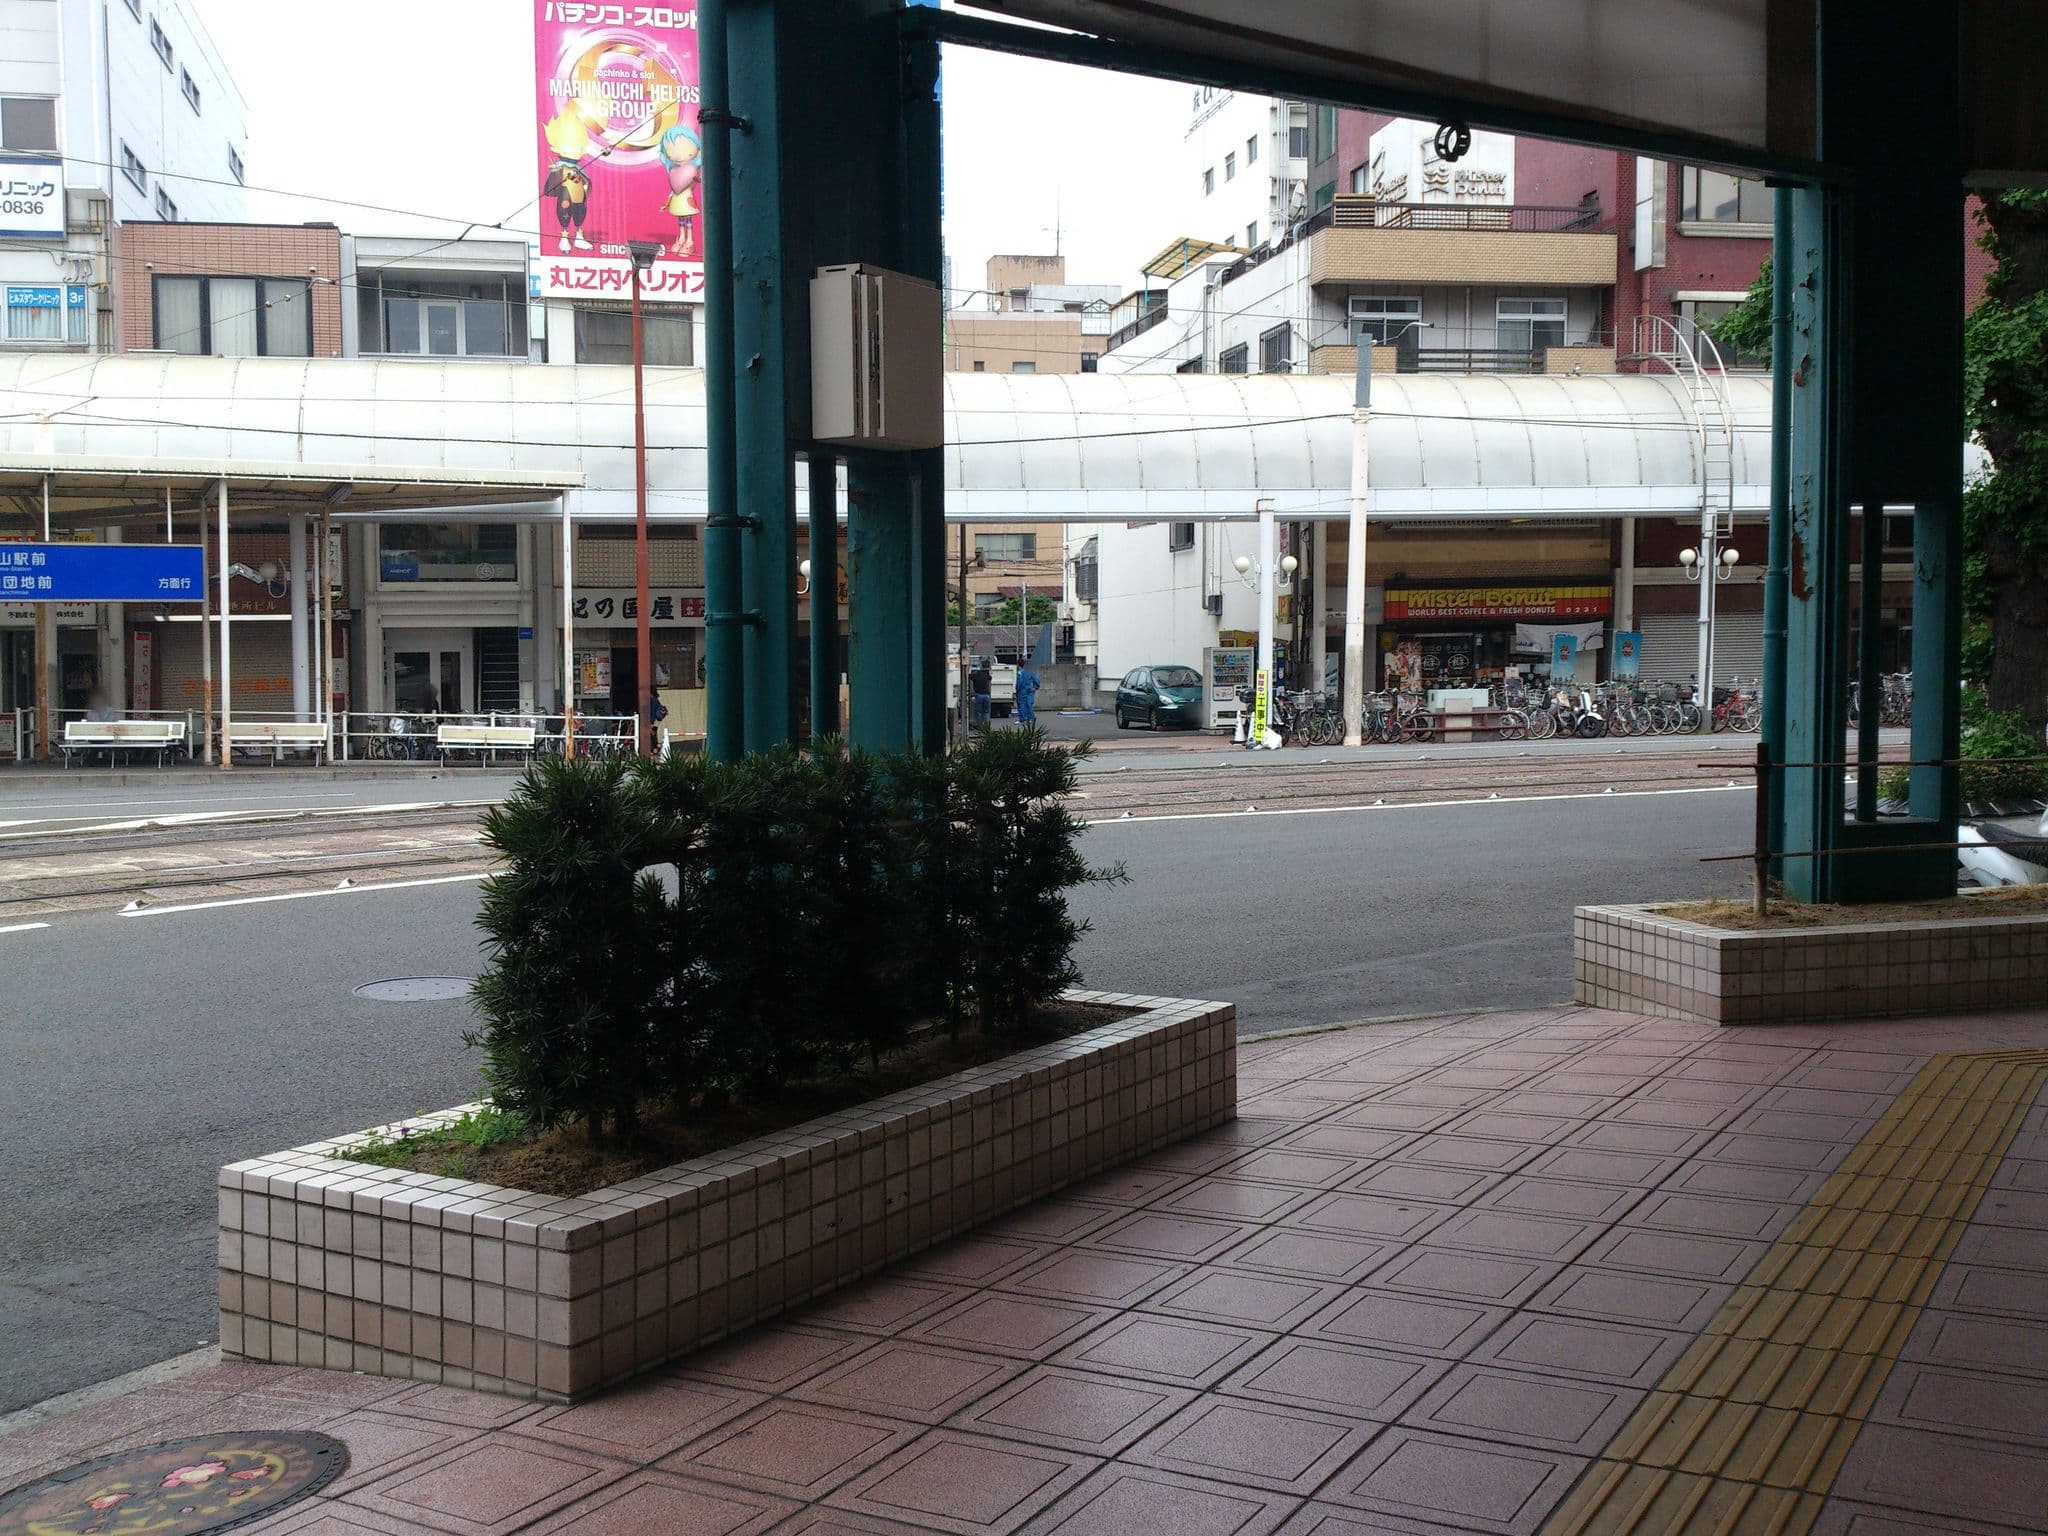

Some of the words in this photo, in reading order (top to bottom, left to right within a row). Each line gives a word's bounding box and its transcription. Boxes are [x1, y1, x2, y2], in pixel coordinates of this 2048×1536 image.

[632, 70, 638, 79] &
[640, 69, 655, 80] slot
[550, 79, 644, 101] MARUNOUCHI
[651, 84, 699, 104] HELIOS
[602, 100, 657, 119] GROUP
[0, 181, 54, 197] リニック
[1455, 184, 1507, 196] Donut
[69, 291, 84, 303] 3F
[158, 577, 192, 590] 方面行
[1408, 608, 1436, 616] WORLD
[1439, 608, 1457, 616] BEST
[1460, 607, 1487, 615] COFFEE
[1525, 606, 1556, 614] DONUTS
